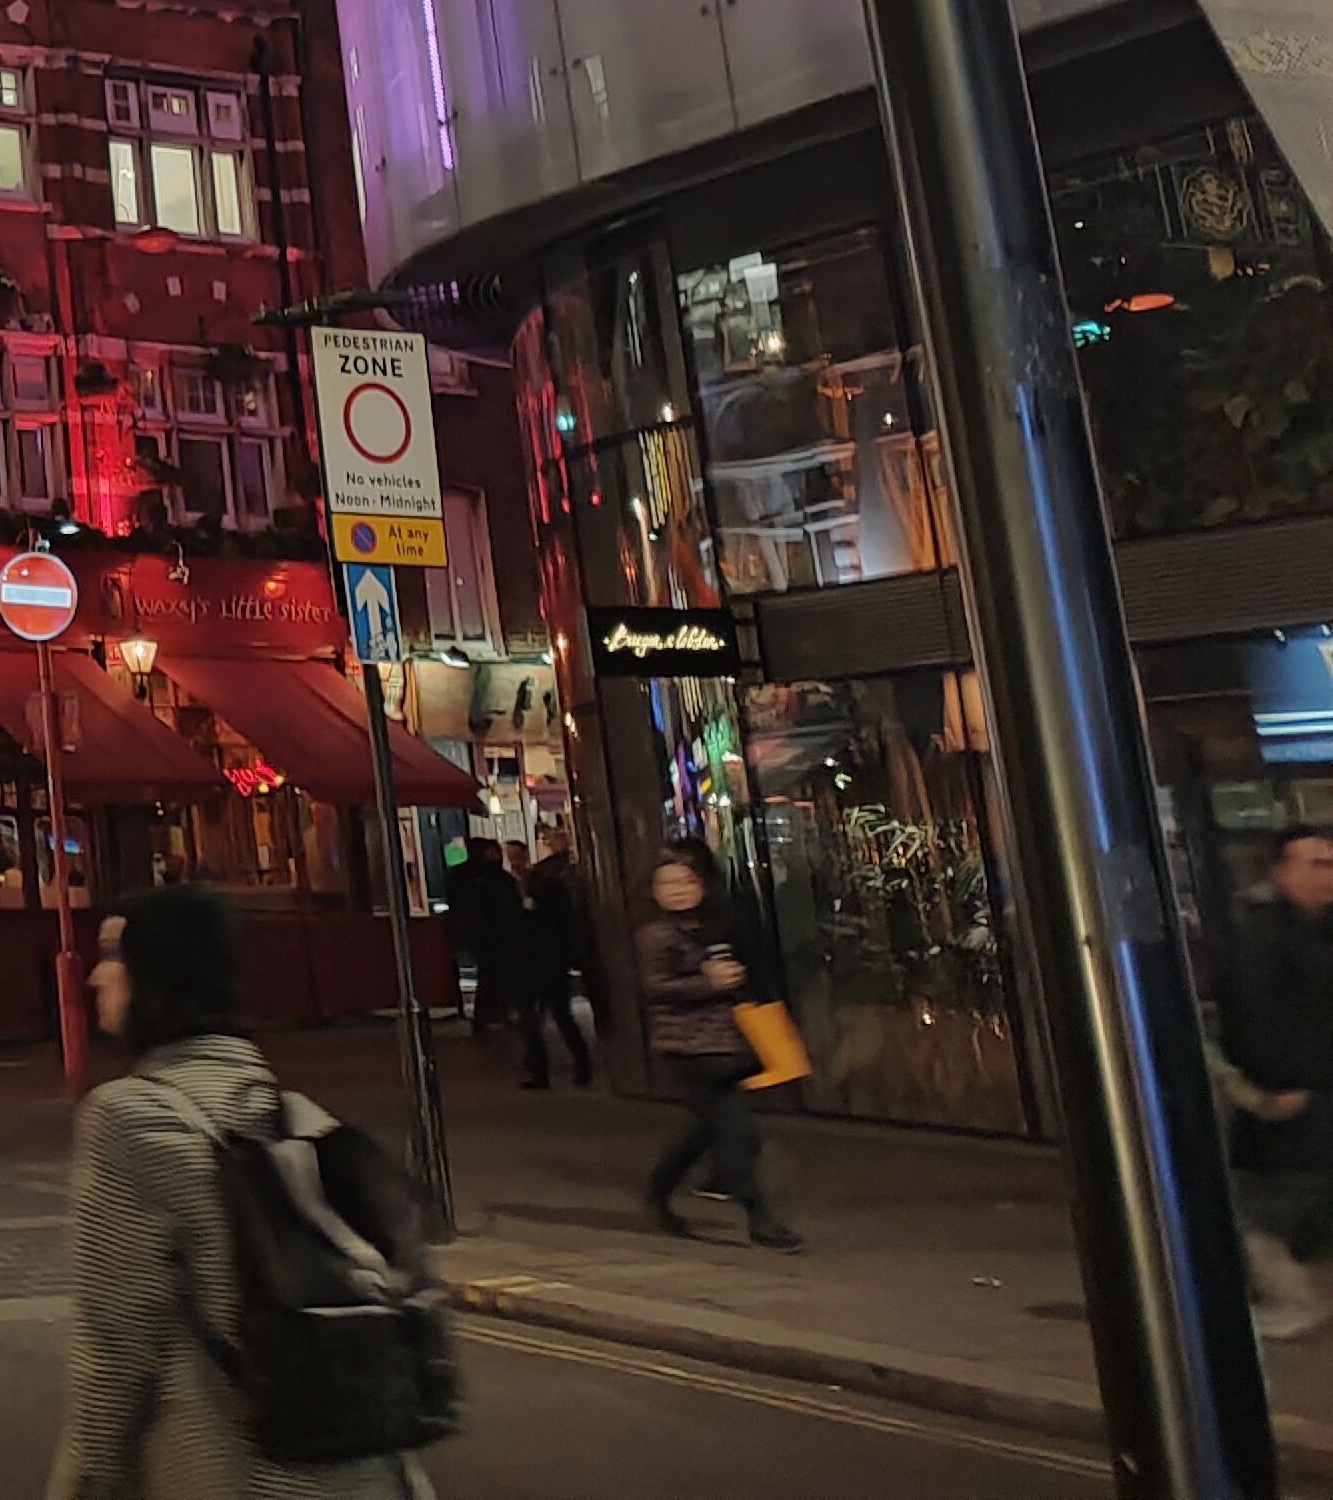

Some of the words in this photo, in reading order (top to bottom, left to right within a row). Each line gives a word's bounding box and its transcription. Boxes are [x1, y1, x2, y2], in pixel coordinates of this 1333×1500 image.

[323, 334, 415, 352] PEDESTRIAN
[338, 354, 404, 378] ZONE
[346, 471, 364, 486] No
[370, 472, 421, 489] vehicles
[335, 491, 370, 507] Noon
[380, 494, 437, 512] Midnight
[388, 524, 404, 541] At
[407, 528, 429, 543] any
[396, 543, 424, 557] time
